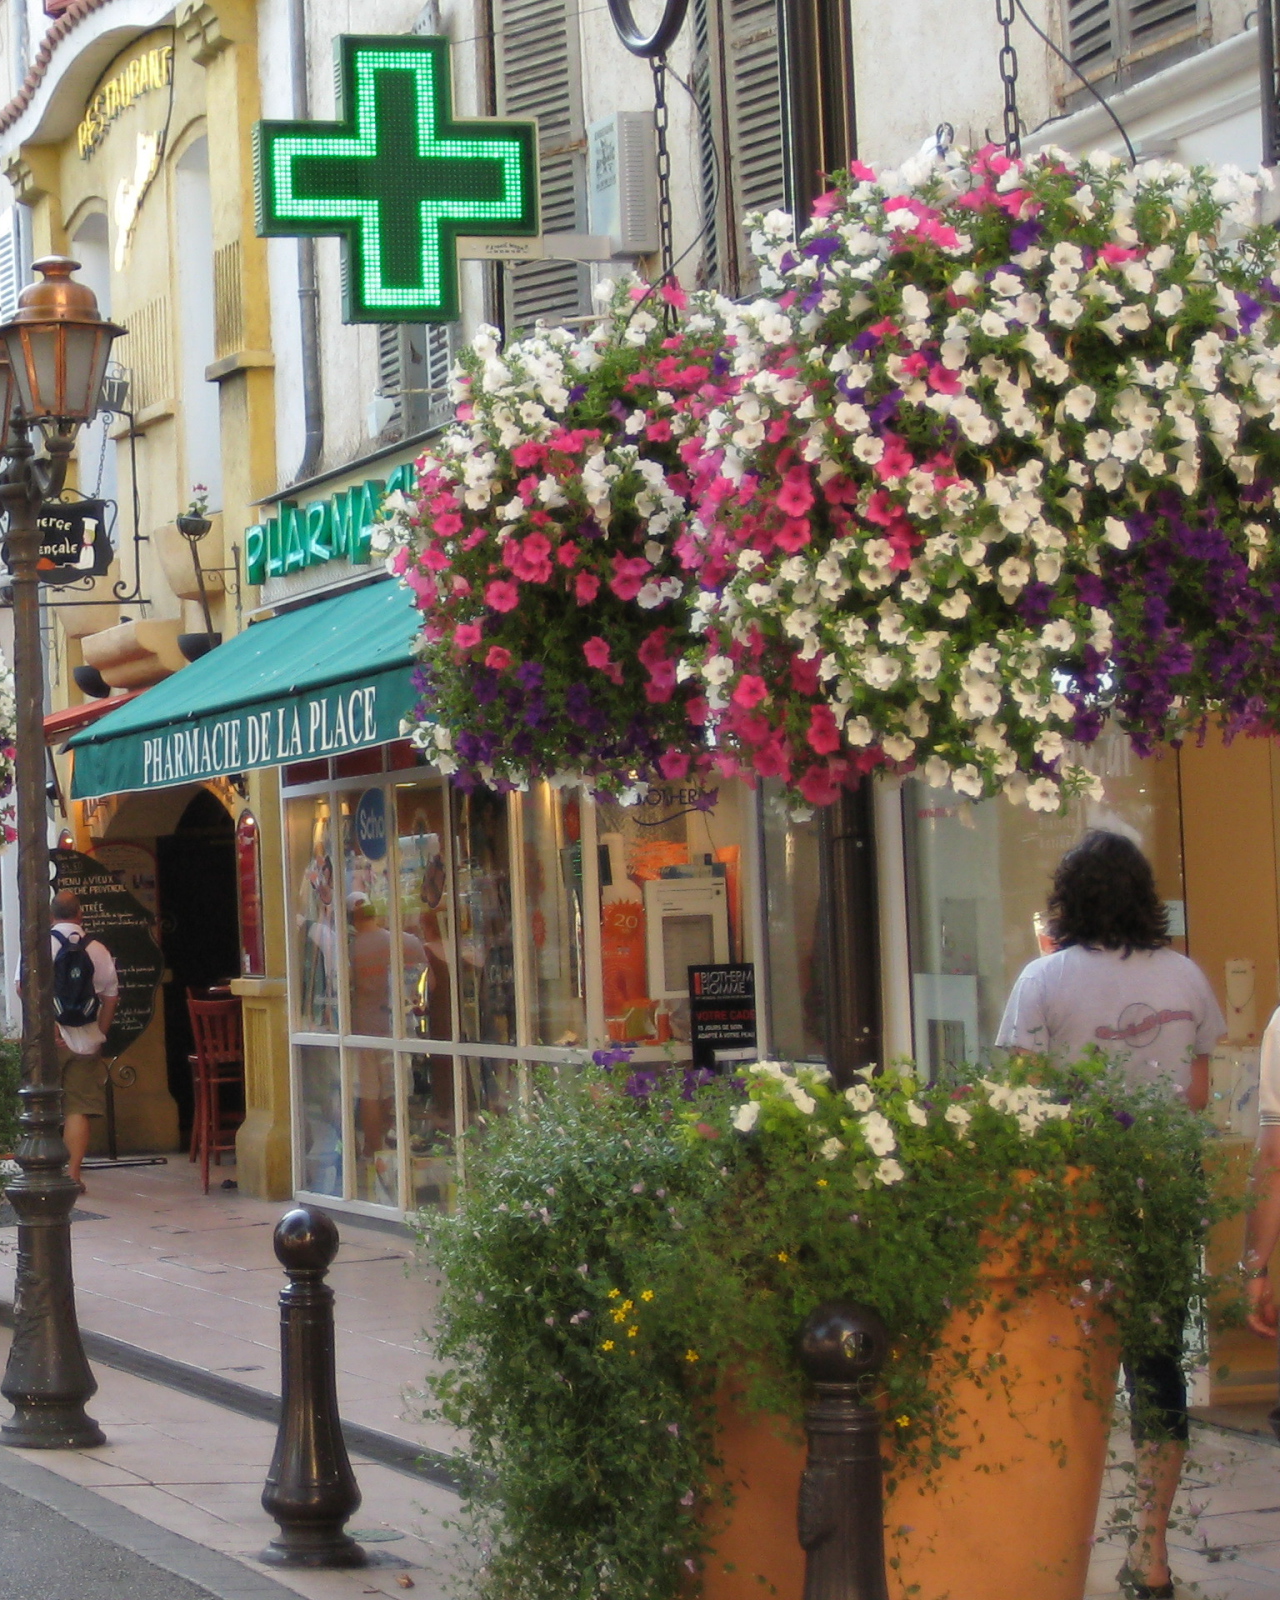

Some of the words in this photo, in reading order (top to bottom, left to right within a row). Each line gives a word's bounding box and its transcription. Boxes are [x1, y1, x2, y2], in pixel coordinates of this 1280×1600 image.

[77, 46, 173, 160] RESTAURANT
[35, 516, 73, 531] erge
[38, 536, 79, 556] ençale
[142, 719, 242, 785] PHARMACIE
[247, 711, 272, 765] DE
[276, 705, 303, 759] LA
[308, 686, 377, 753] PLACE
[614, 913, 638, 929] 20
[700, 970, 754, 984] BIOTHERM
[702, 982, 746, 995] HOMME
